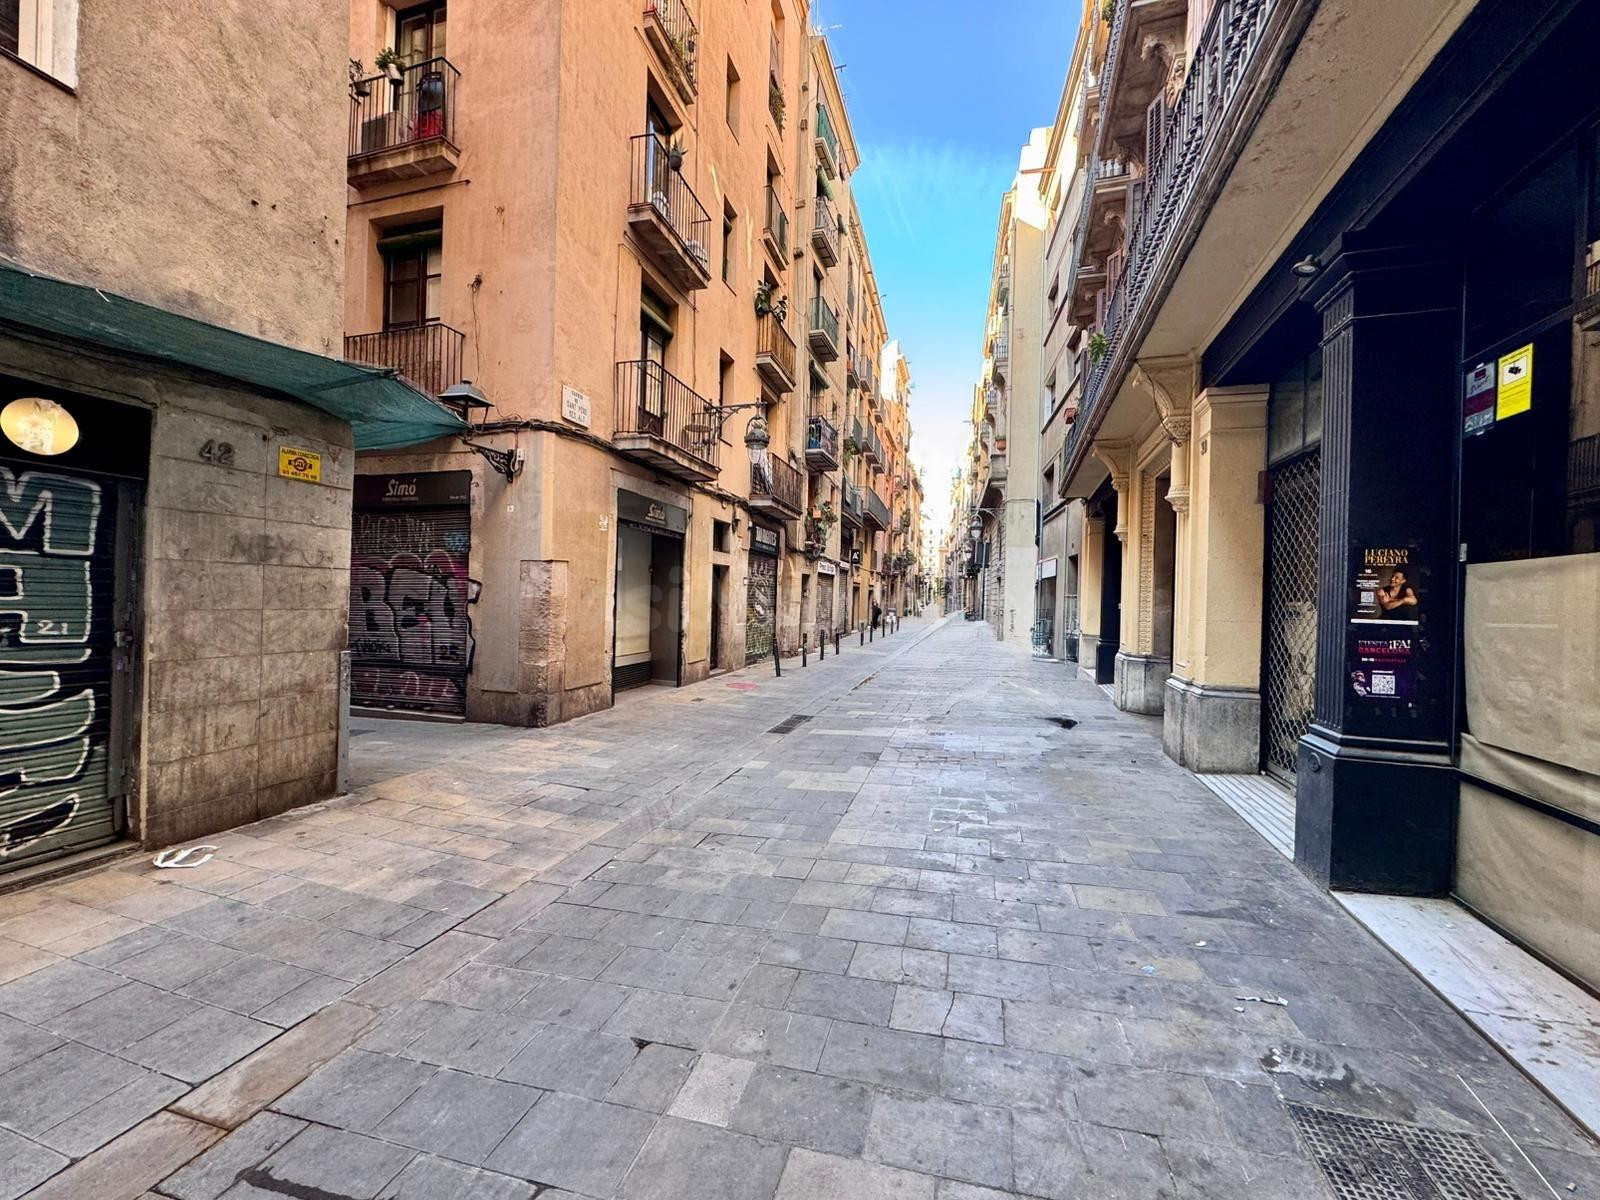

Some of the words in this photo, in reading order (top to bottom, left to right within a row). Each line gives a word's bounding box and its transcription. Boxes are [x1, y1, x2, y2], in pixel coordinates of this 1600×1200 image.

[199, 439, 235, 465] 42
[385, 478, 417, 496] Simó
[1364, 548, 1409, 557] LUCIANO
[1364, 556, 1409, 564] PEREYRA
[1389, 639, 1411, 650] ¡FA!
